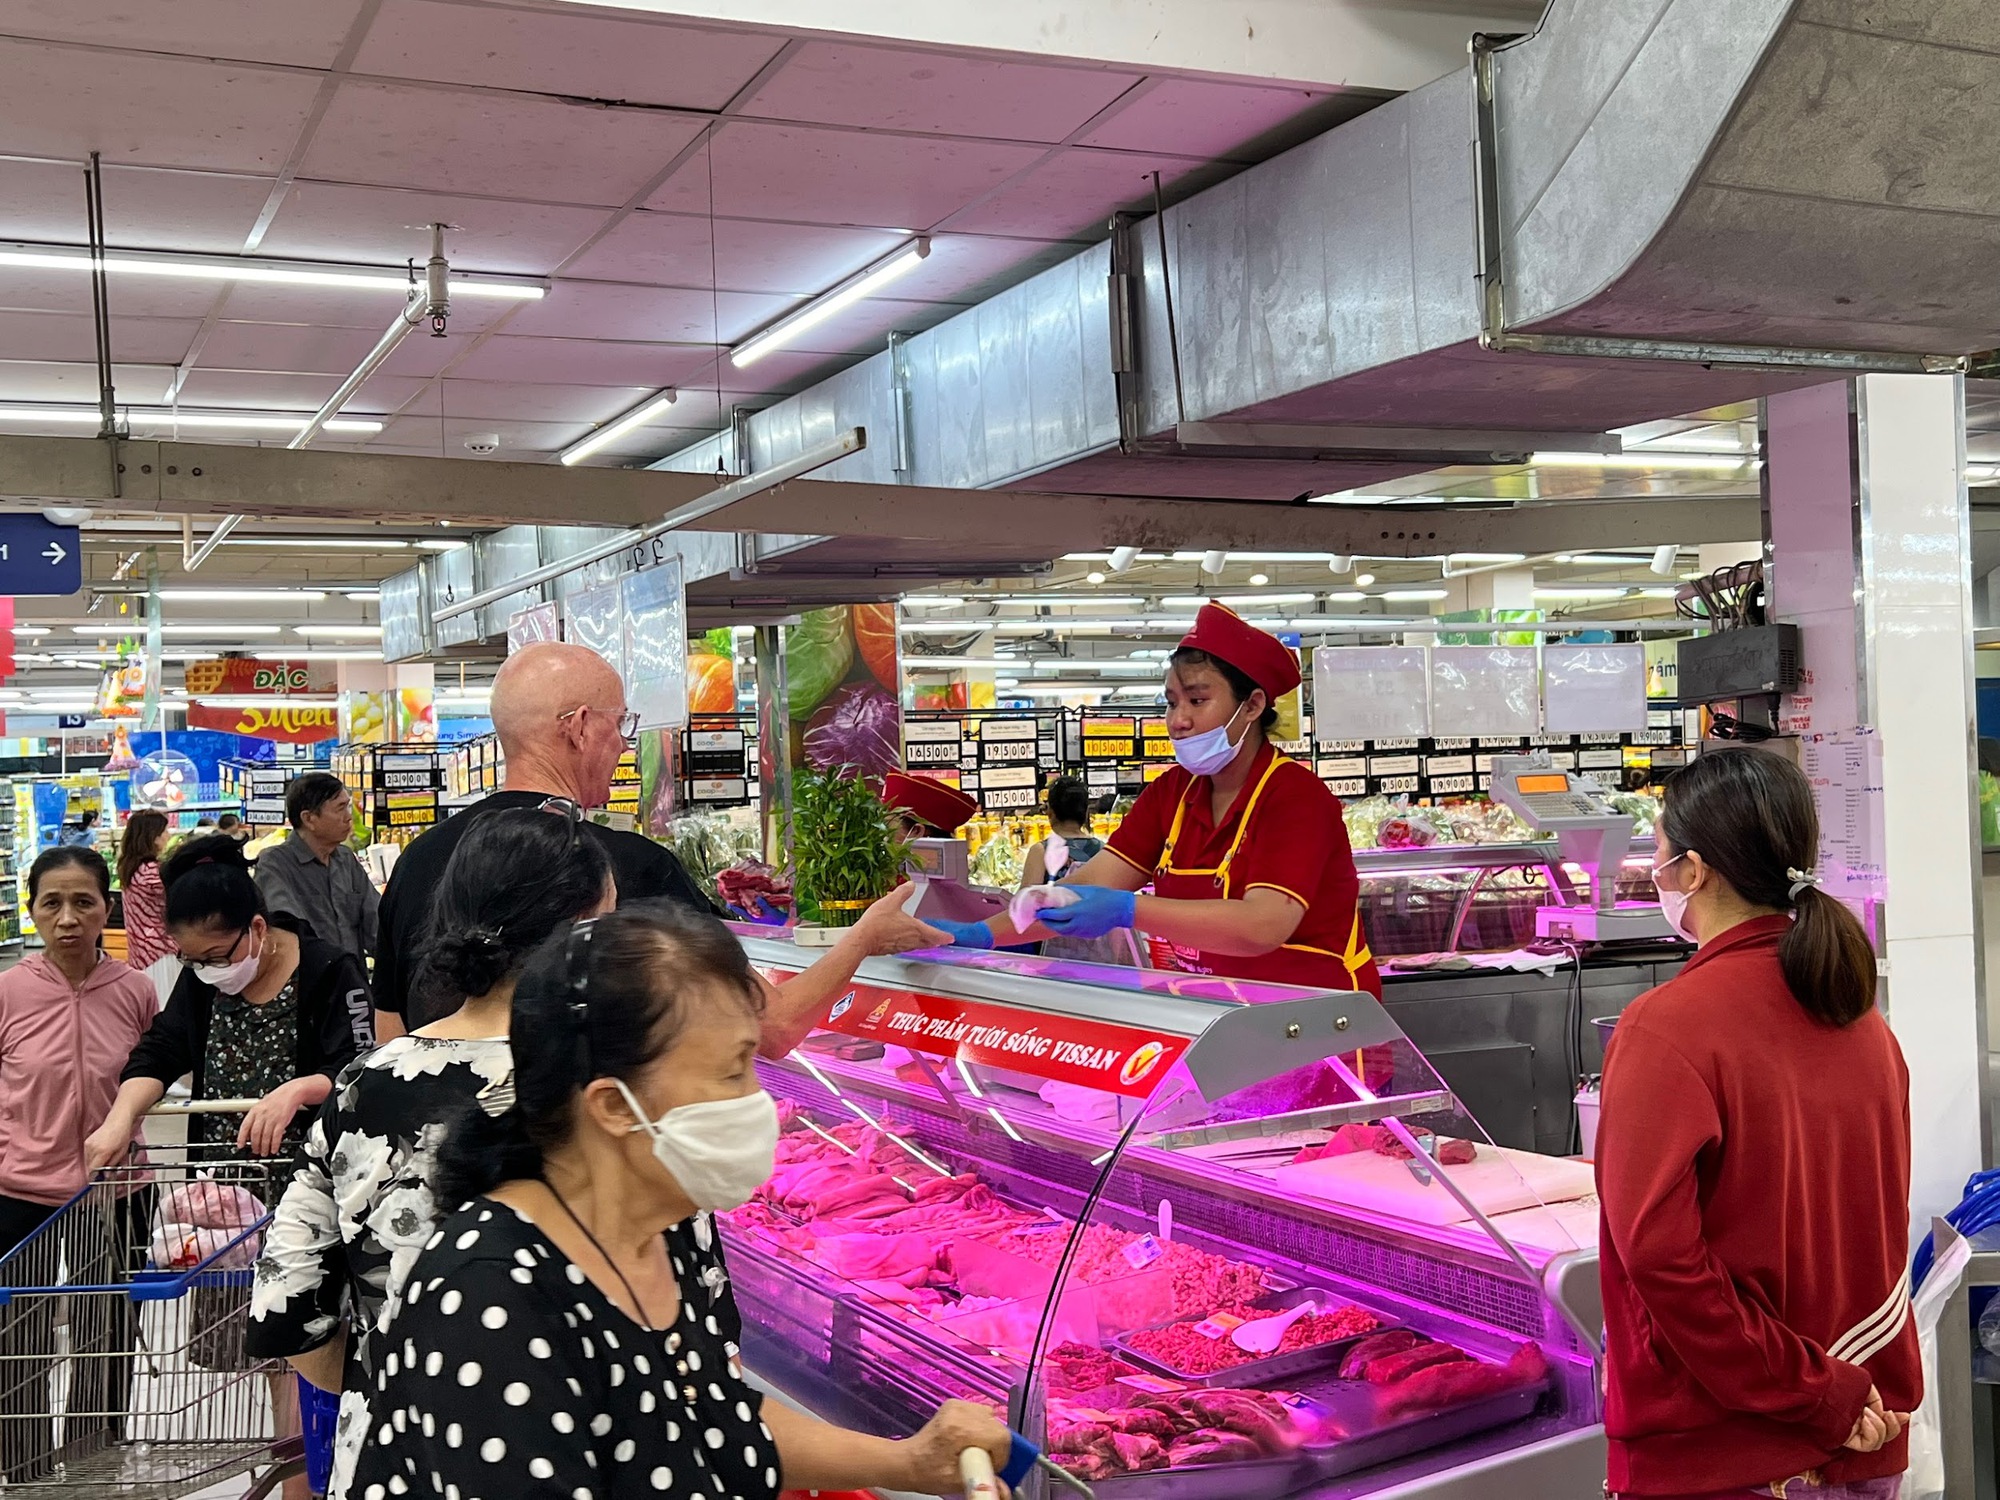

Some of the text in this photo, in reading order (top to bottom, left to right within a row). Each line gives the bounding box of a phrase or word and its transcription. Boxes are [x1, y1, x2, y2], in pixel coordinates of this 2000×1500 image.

[254, 665, 308, 693] ĐẶC
[908, 746, 949, 758] 16.500
[987, 745, 1026, 756] 19.500
[1432, 778, 1465, 788] 19.900
[987, 793, 1026, 805] 17.500
[887, 1011, 1121, 1071] THỰC PHẨM TƯƠI SỐNG VISSAN
